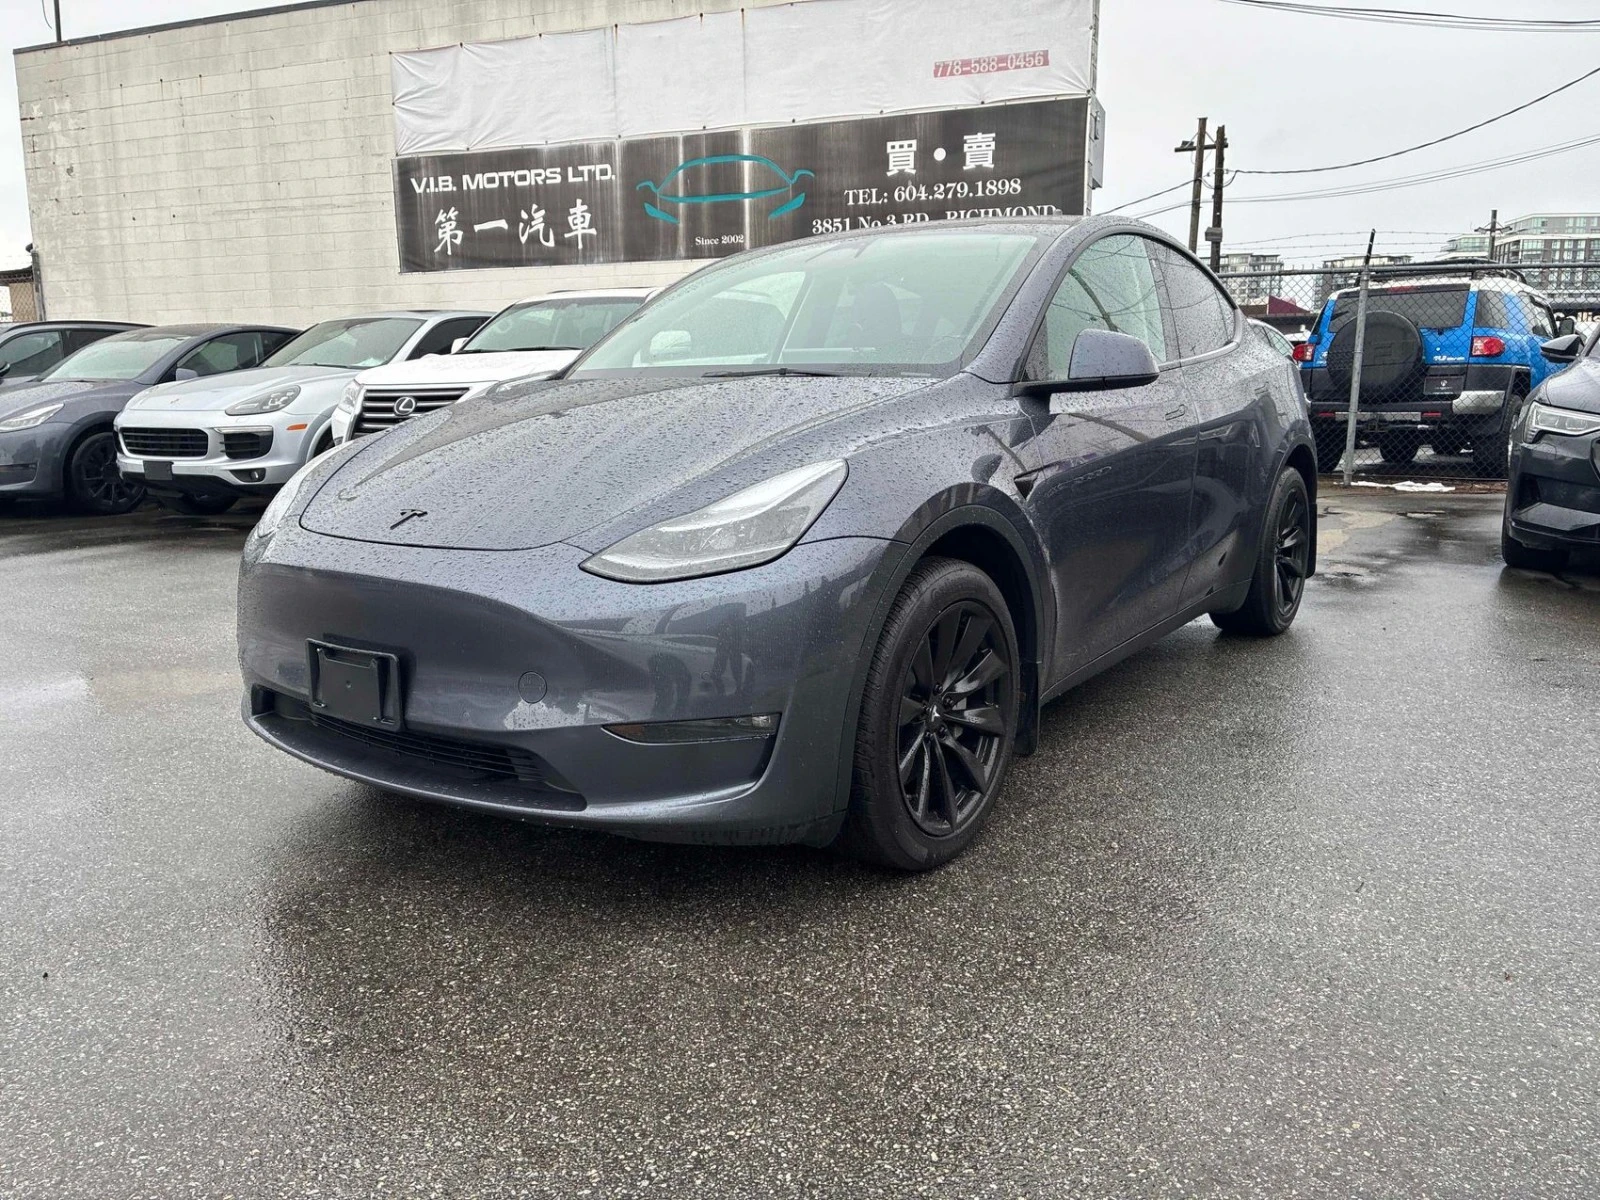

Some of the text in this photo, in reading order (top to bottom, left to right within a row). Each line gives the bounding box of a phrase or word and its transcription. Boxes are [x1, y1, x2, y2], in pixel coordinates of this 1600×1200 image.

[935, 51, 1045, 77] 778-588-0456
[410, 163, 616, 194] V.I.B. MOTORS LTD.
[844, 177, 1022, 206] TEL: 604.279.1898
[433, 198, 598, 256] 第一汽車
[811, 216, 851, 235] 3851
[945, 204, 1057, 221] RICHMOND
[694, 234, 745, 246] Since 2002
